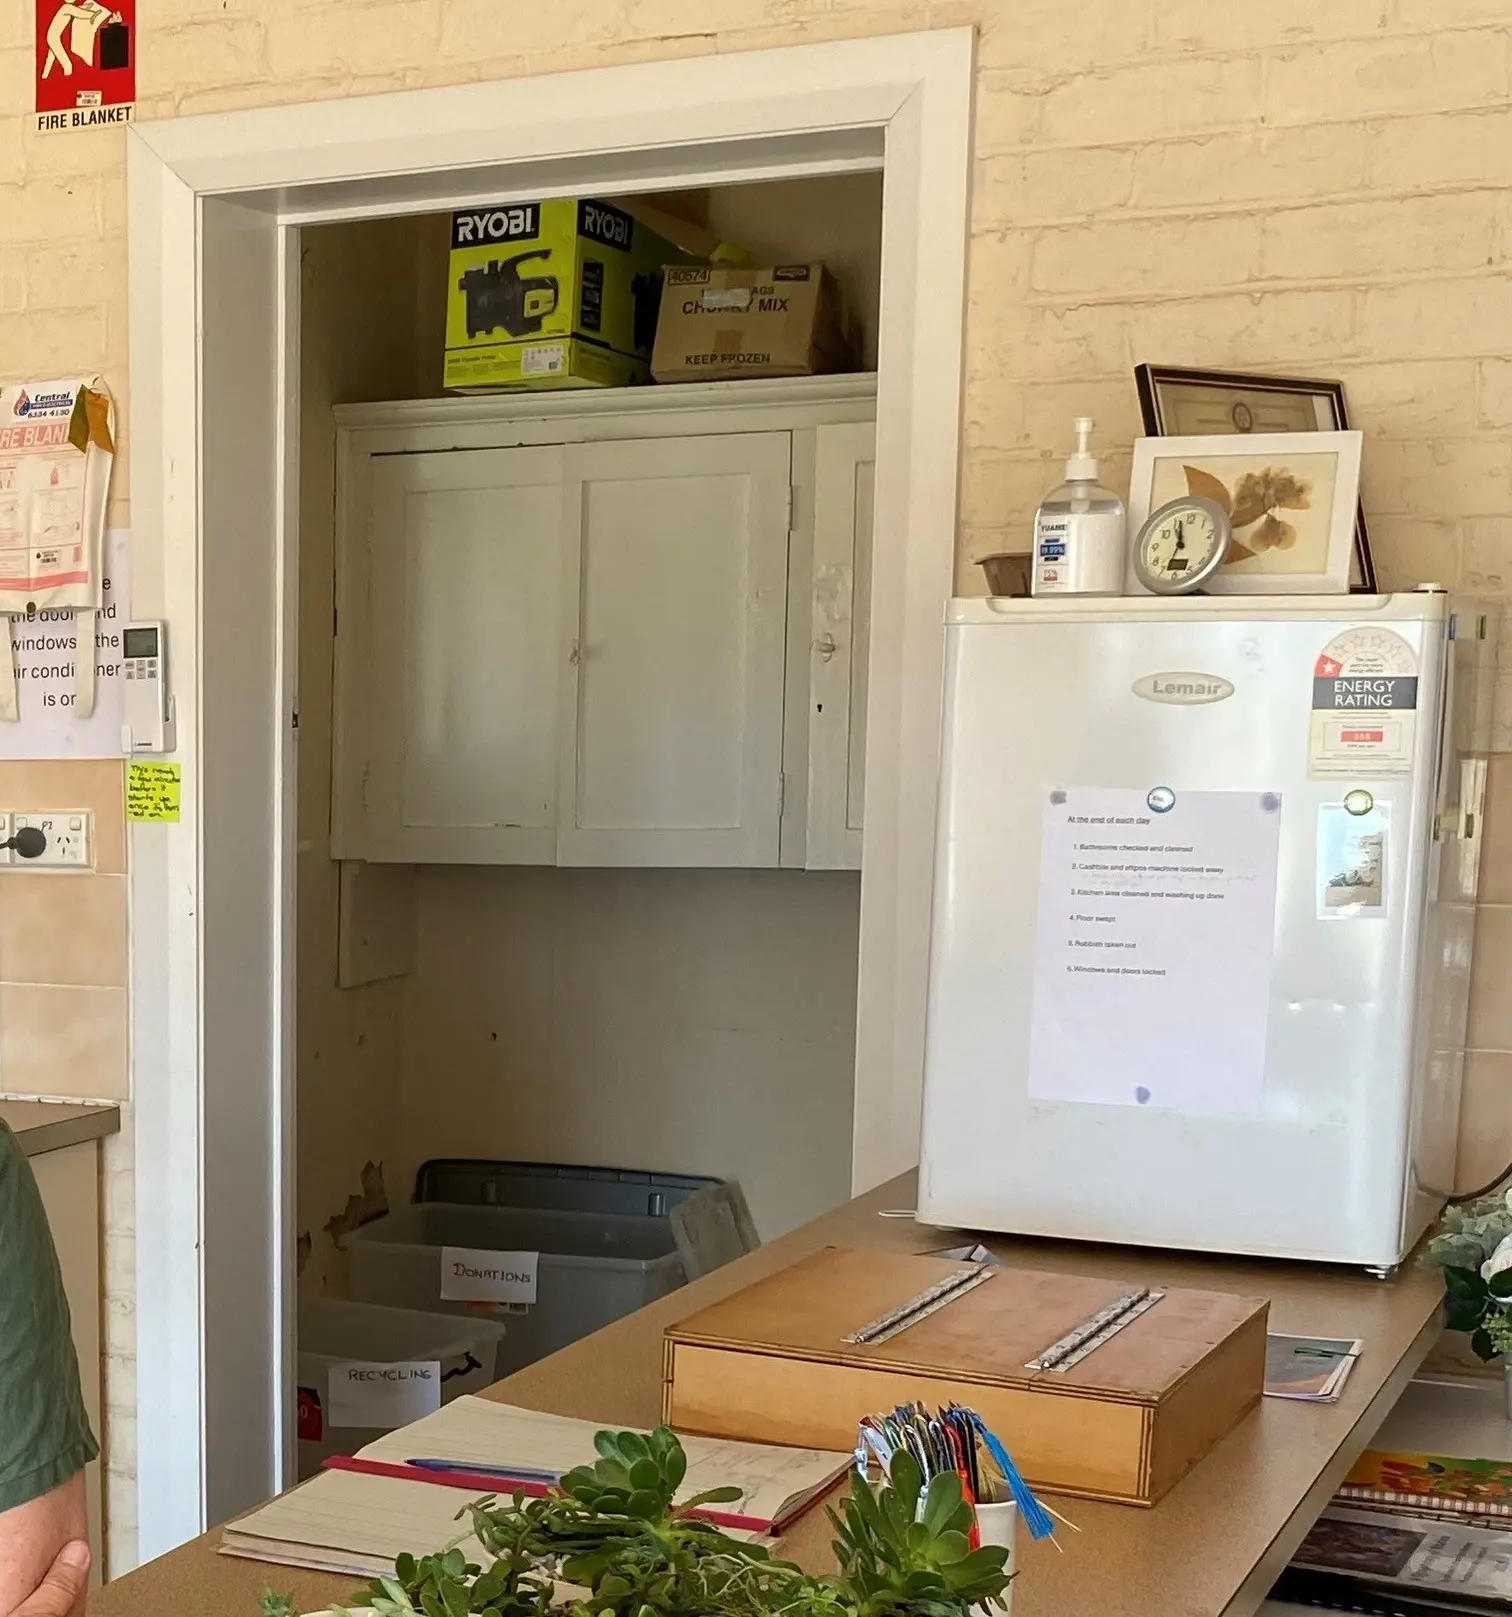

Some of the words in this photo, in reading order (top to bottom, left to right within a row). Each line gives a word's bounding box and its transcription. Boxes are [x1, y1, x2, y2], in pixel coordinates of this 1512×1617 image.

[38, 113, 67, 131] FIRE
[72, 106, 132, 127] BLANKET
[456, 207, 533, 242] RYOBI
[585, 205, 628, 245] RYOBI
[758, 298, 790, 312] MIX
[685, 353, 718, 365] KEEP
[24, 423, 69, 447] BLAN
[95, 603, 117, 619] nd
[11, 635, 77, 651] windows
[95, 634, 119, 648] the
[14, 665, 27, 679] ir
[1152, 680, 1222, 695] Lemair
[1334, 680, 1395, 693] ENERGY
[43, 692, 56, 707] is
[1335, 694, 1393, 707] RATING
[453, 1262, 531, 1283] DONATIONS
[348, 1368, 432, 1382] RECYCLING
